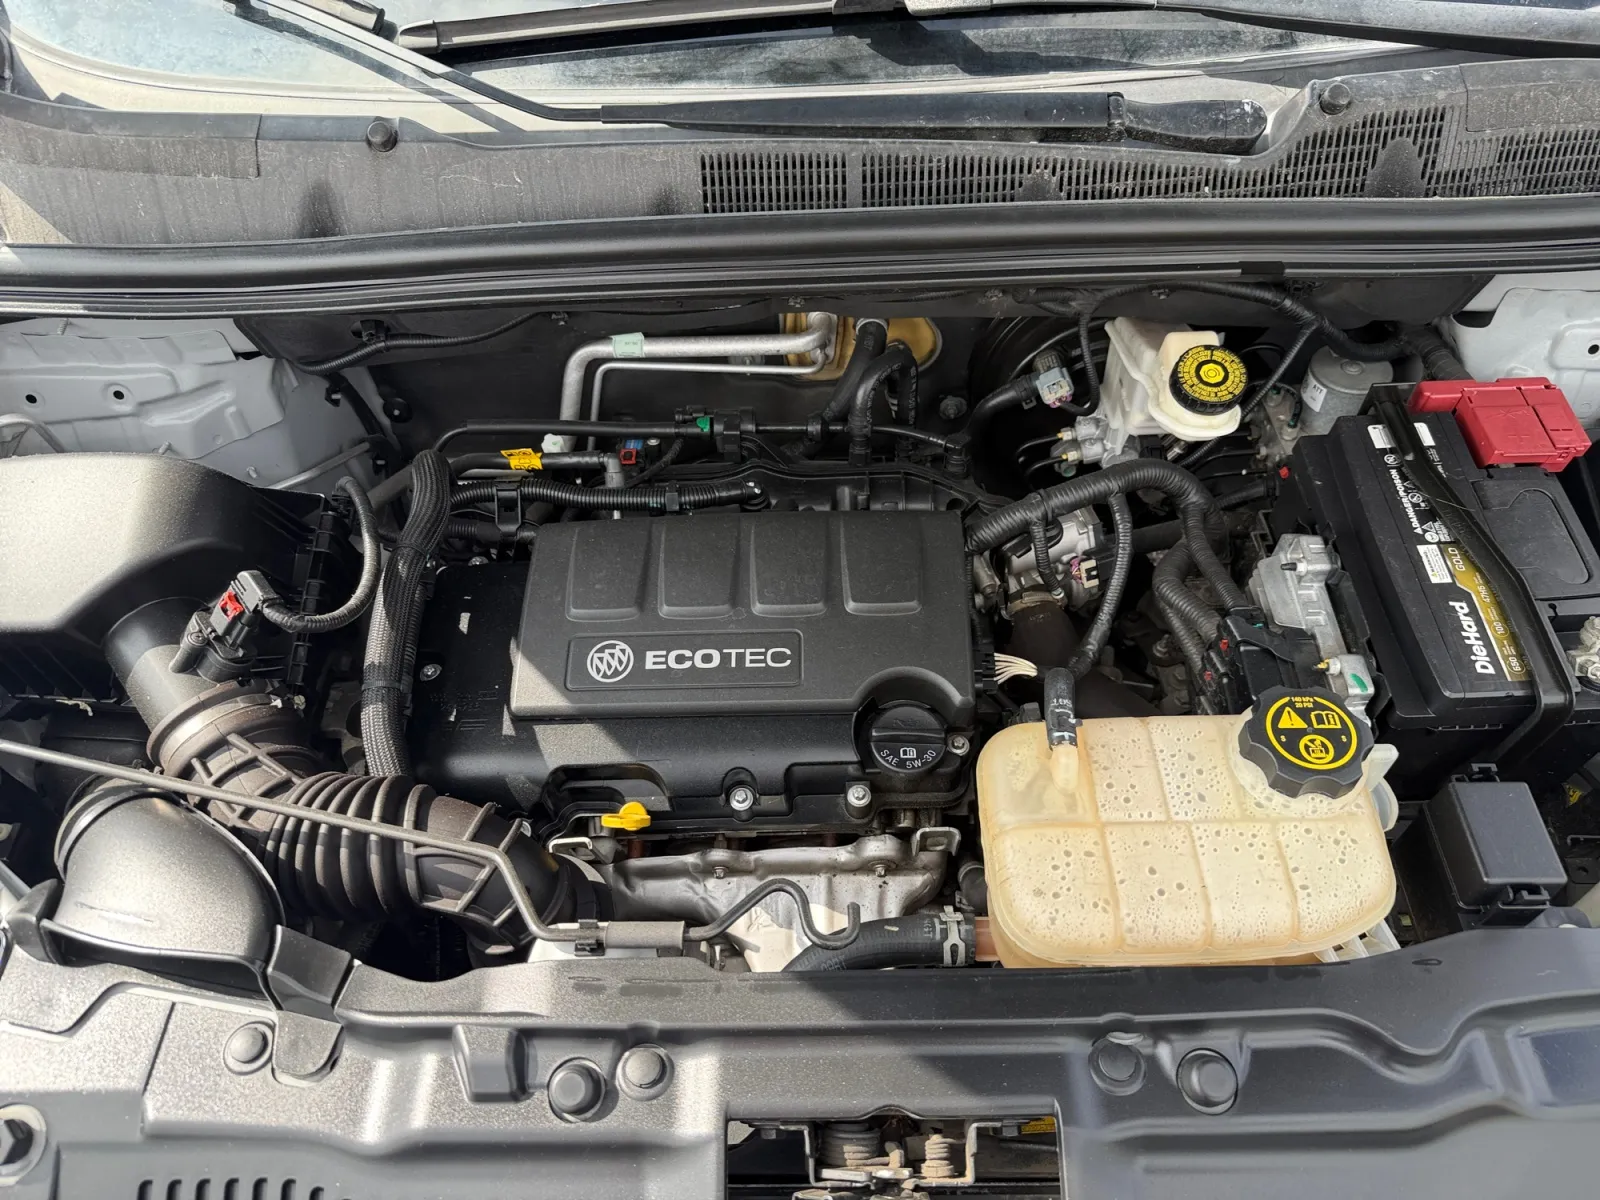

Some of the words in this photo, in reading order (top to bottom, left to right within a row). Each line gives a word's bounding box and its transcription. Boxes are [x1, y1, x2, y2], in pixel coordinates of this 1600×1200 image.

[1448, 547, 1466, 571] GOLD
[1448, 601, 1496, 674] DieHard
[1493, 621, 1506, 634] 100
[645, 647, 792, 670] ECOTEC
[1508, 656, 1522, 671] 650
[880, 749, 900, 767] SAE
[906, 749, 937, 769] 5W-30
